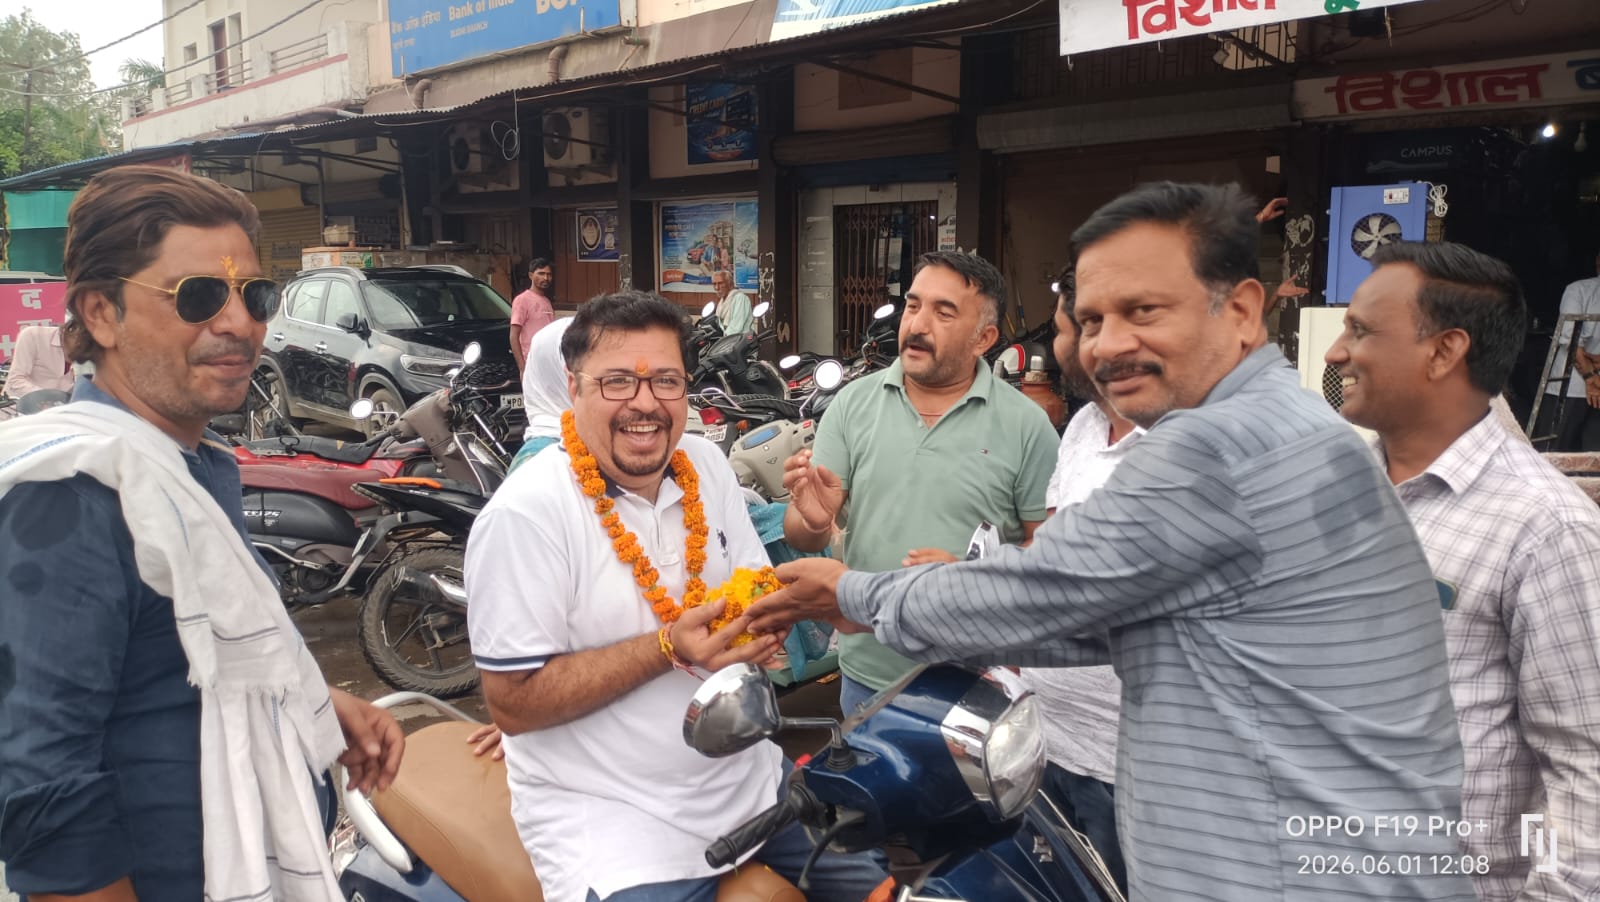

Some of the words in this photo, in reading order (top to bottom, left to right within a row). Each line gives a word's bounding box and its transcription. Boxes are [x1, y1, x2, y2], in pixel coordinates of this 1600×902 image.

[448, 1, 473, 21] Bank
[1324, 63, 1549, 114] विशाल
[1400, 144, 1453, 158] CAMPUS
